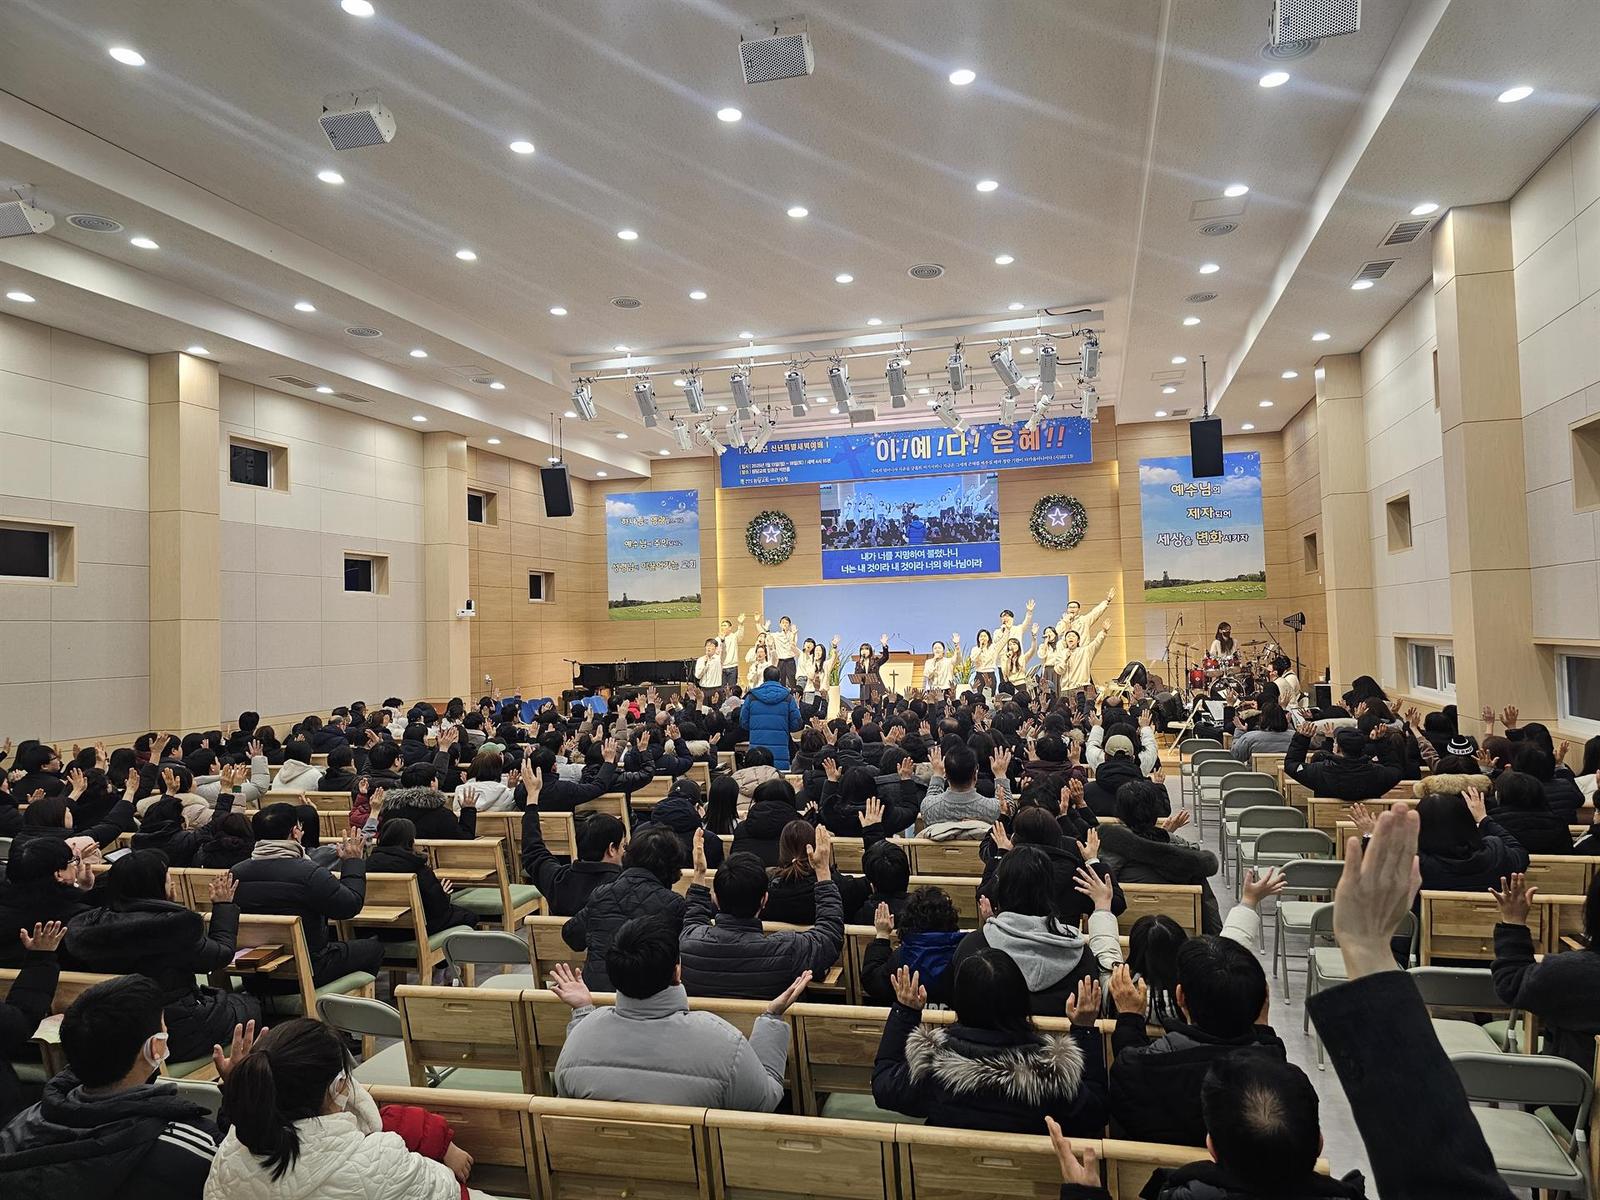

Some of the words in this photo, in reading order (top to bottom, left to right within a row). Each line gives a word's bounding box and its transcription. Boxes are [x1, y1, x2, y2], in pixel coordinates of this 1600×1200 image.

[1170, 482, 1221, 497] 예수님의
[1187, 507, 1231, 519] 제자되어
[1157, 532, 1193, 547] 세상을
[1196, 530, 1249, 545] 변화시키자
[860, 552, 876, 562] 내가
[878, 551, 893, 561] 너를
[841, 564, 857, 574] 너는
[858, 564, 866, 573] 내
[867, 562, 890, 573] 것이라
[891, 562, 899, 571] 내
[901, 561, 924, 571] 것이라
[926, 560, 941, 570] 너의
[943, 558, 983, 570] 하나님이라
